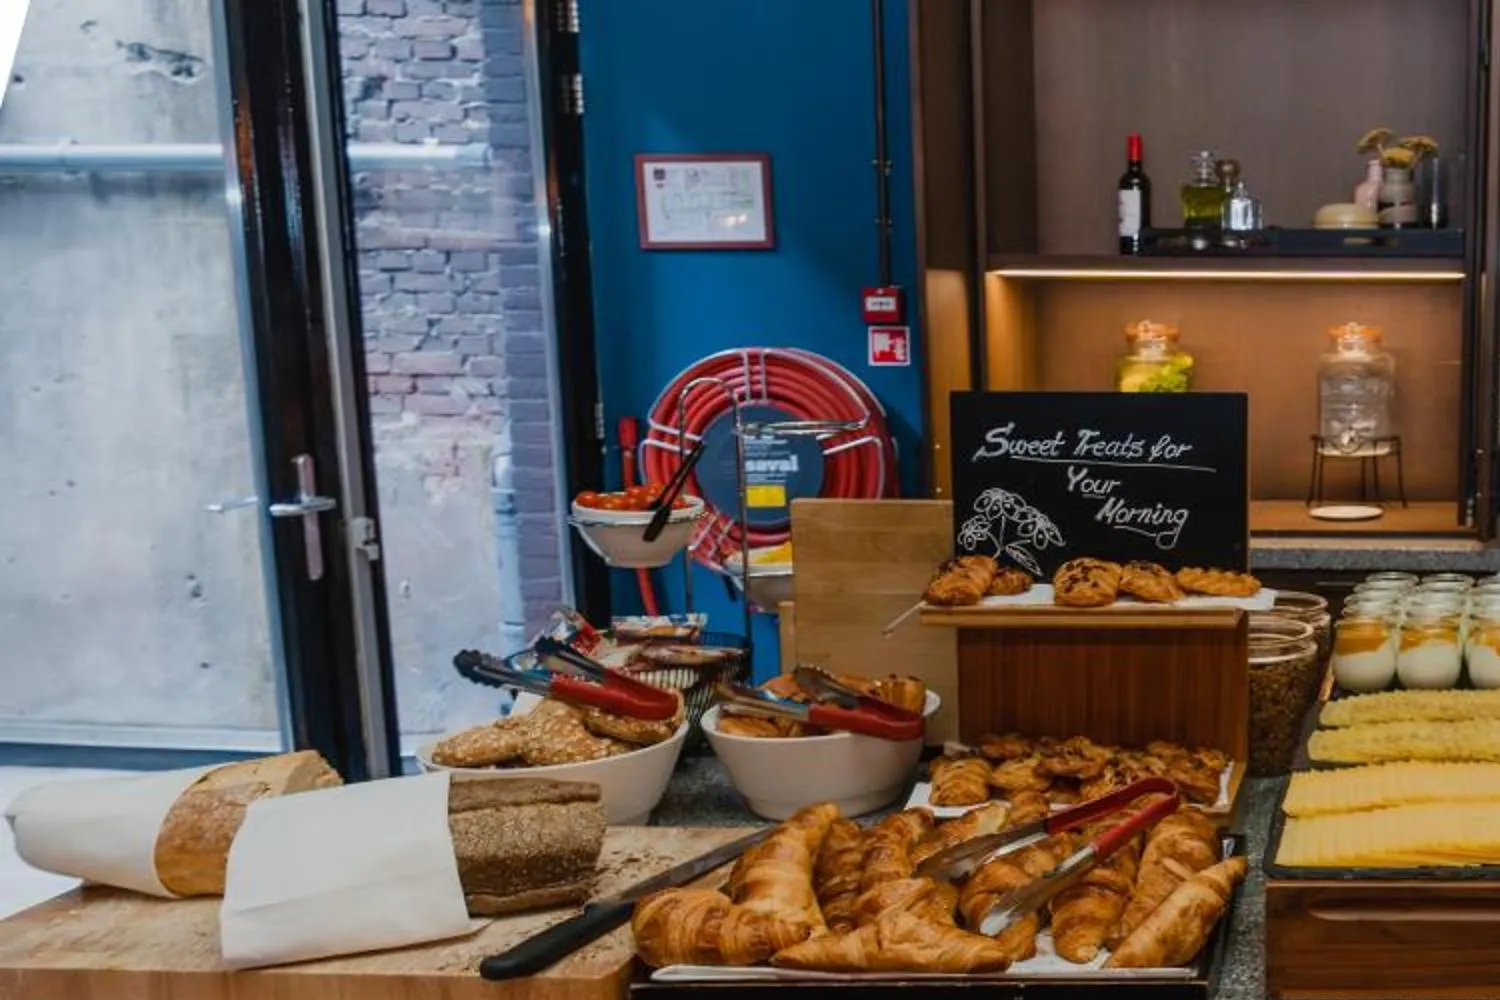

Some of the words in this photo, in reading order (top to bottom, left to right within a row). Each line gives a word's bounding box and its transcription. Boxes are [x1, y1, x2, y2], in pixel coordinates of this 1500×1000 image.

[972, 422, 1066, 462] Sweet
[1074, 429, 1145, 459] Treats
[1149, 434, 1193, 461] for
[1066, 465, 1121, 495] Your
[1094, 497, 1189, 549] Morning
